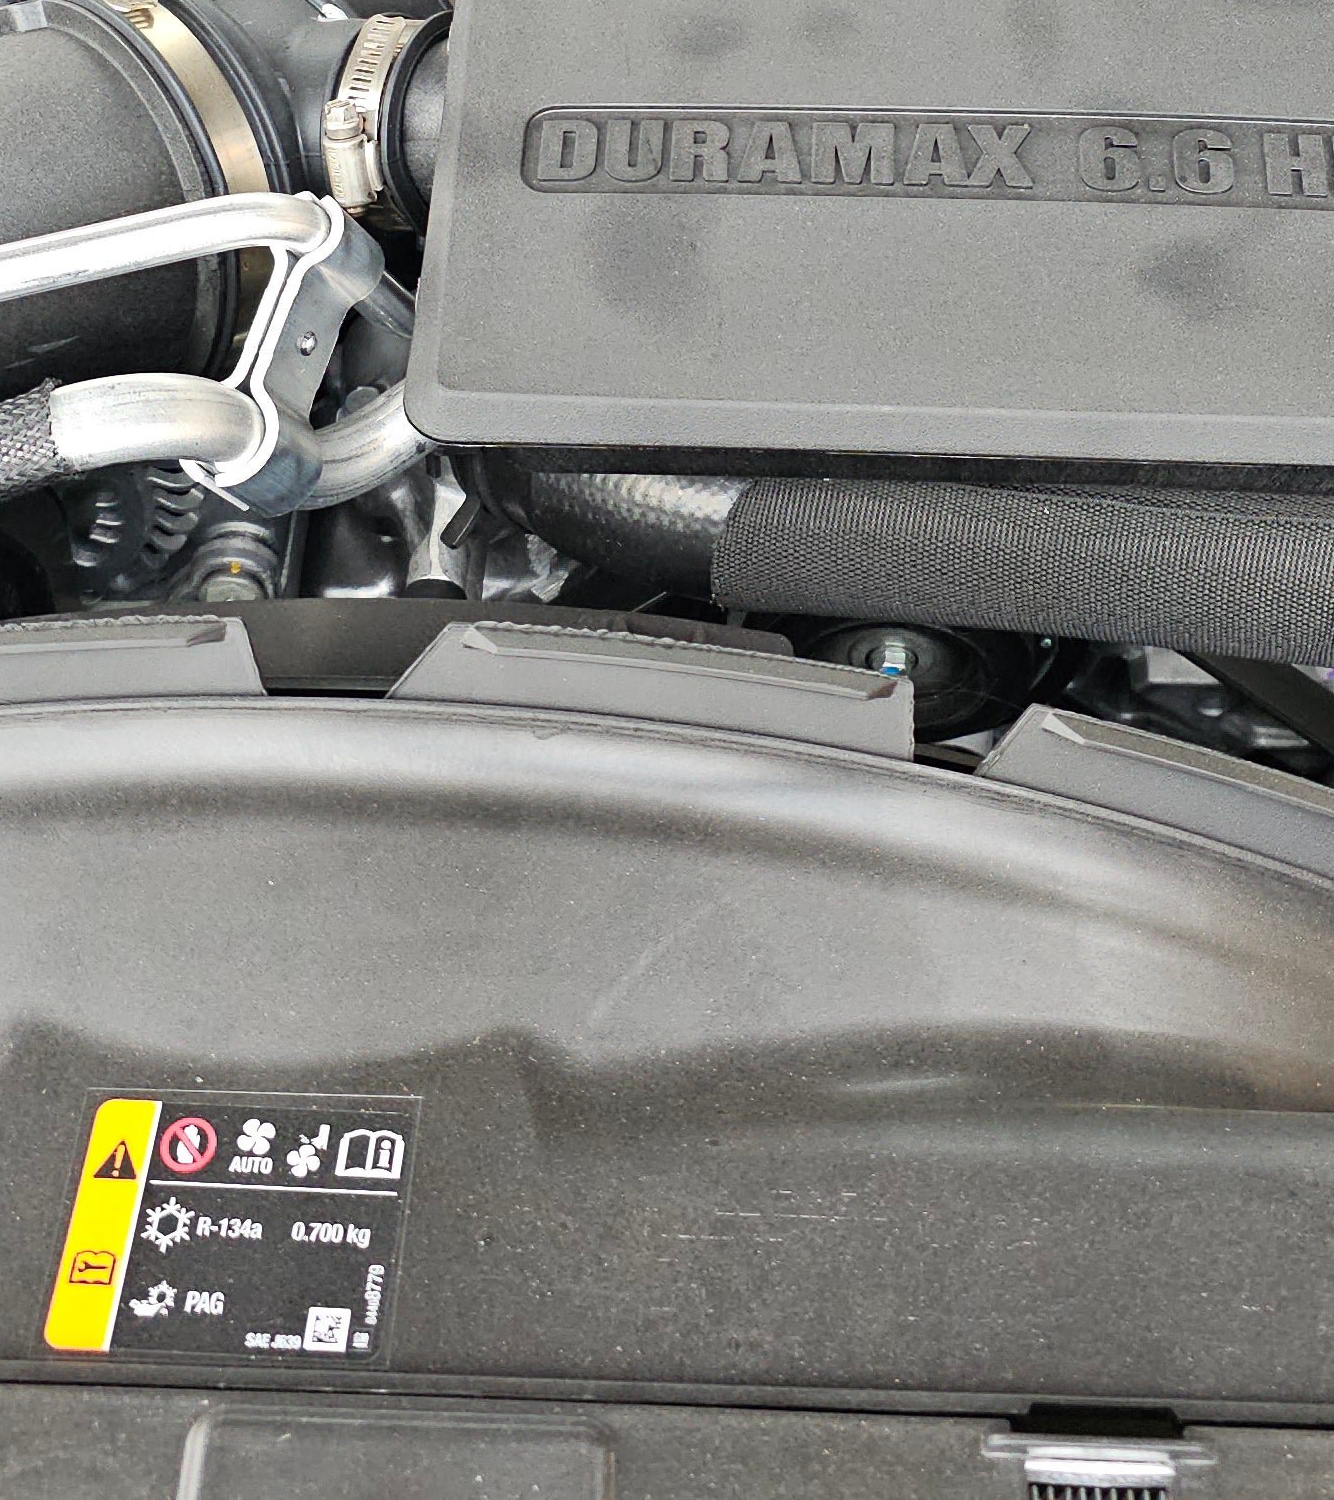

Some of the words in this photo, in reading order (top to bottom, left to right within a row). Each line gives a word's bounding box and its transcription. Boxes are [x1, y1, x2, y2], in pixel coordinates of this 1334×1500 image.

[535, 116, 1036, 191] DURAMAX
[1078, 123, 1235, 197] 6.6
[228, 1155, 274, 1174] AUTO
[195, 1217, 263, 1240] R-134a
[291, 1221, 344, 1243] 0.700
[346, 1223, 372, 1249] kg
[184, 1290, 225, 1316] PAG
[244, 1332, 271, 1349] SAE
